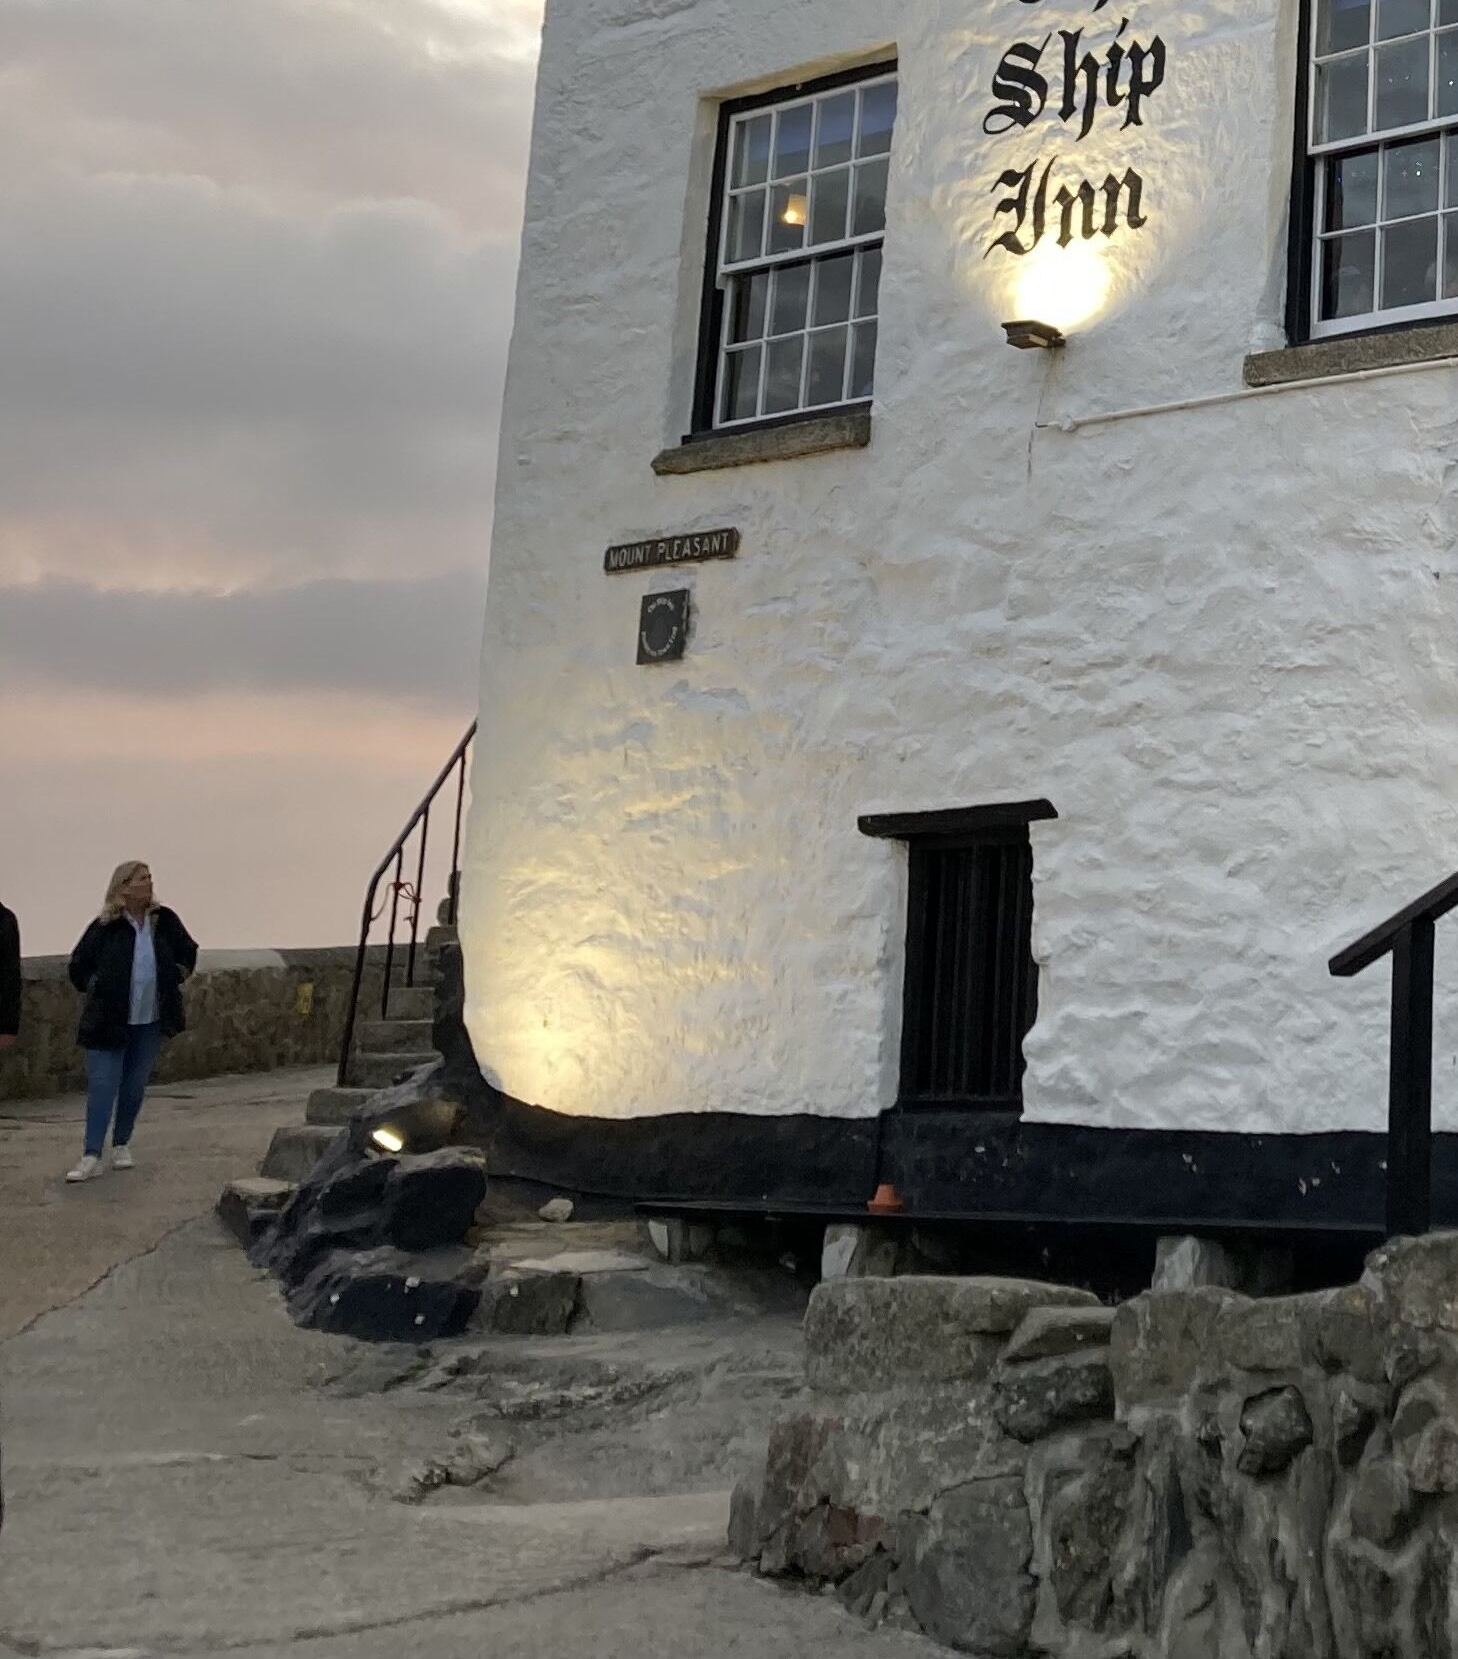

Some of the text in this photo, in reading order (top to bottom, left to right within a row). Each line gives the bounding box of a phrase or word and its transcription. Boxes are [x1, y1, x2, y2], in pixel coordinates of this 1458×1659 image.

[983, 17, 1166, 142] Ship
[983, 155, 1147, 259] Inn
[609, 532, 729, 569] MOUNT PLEASANT
